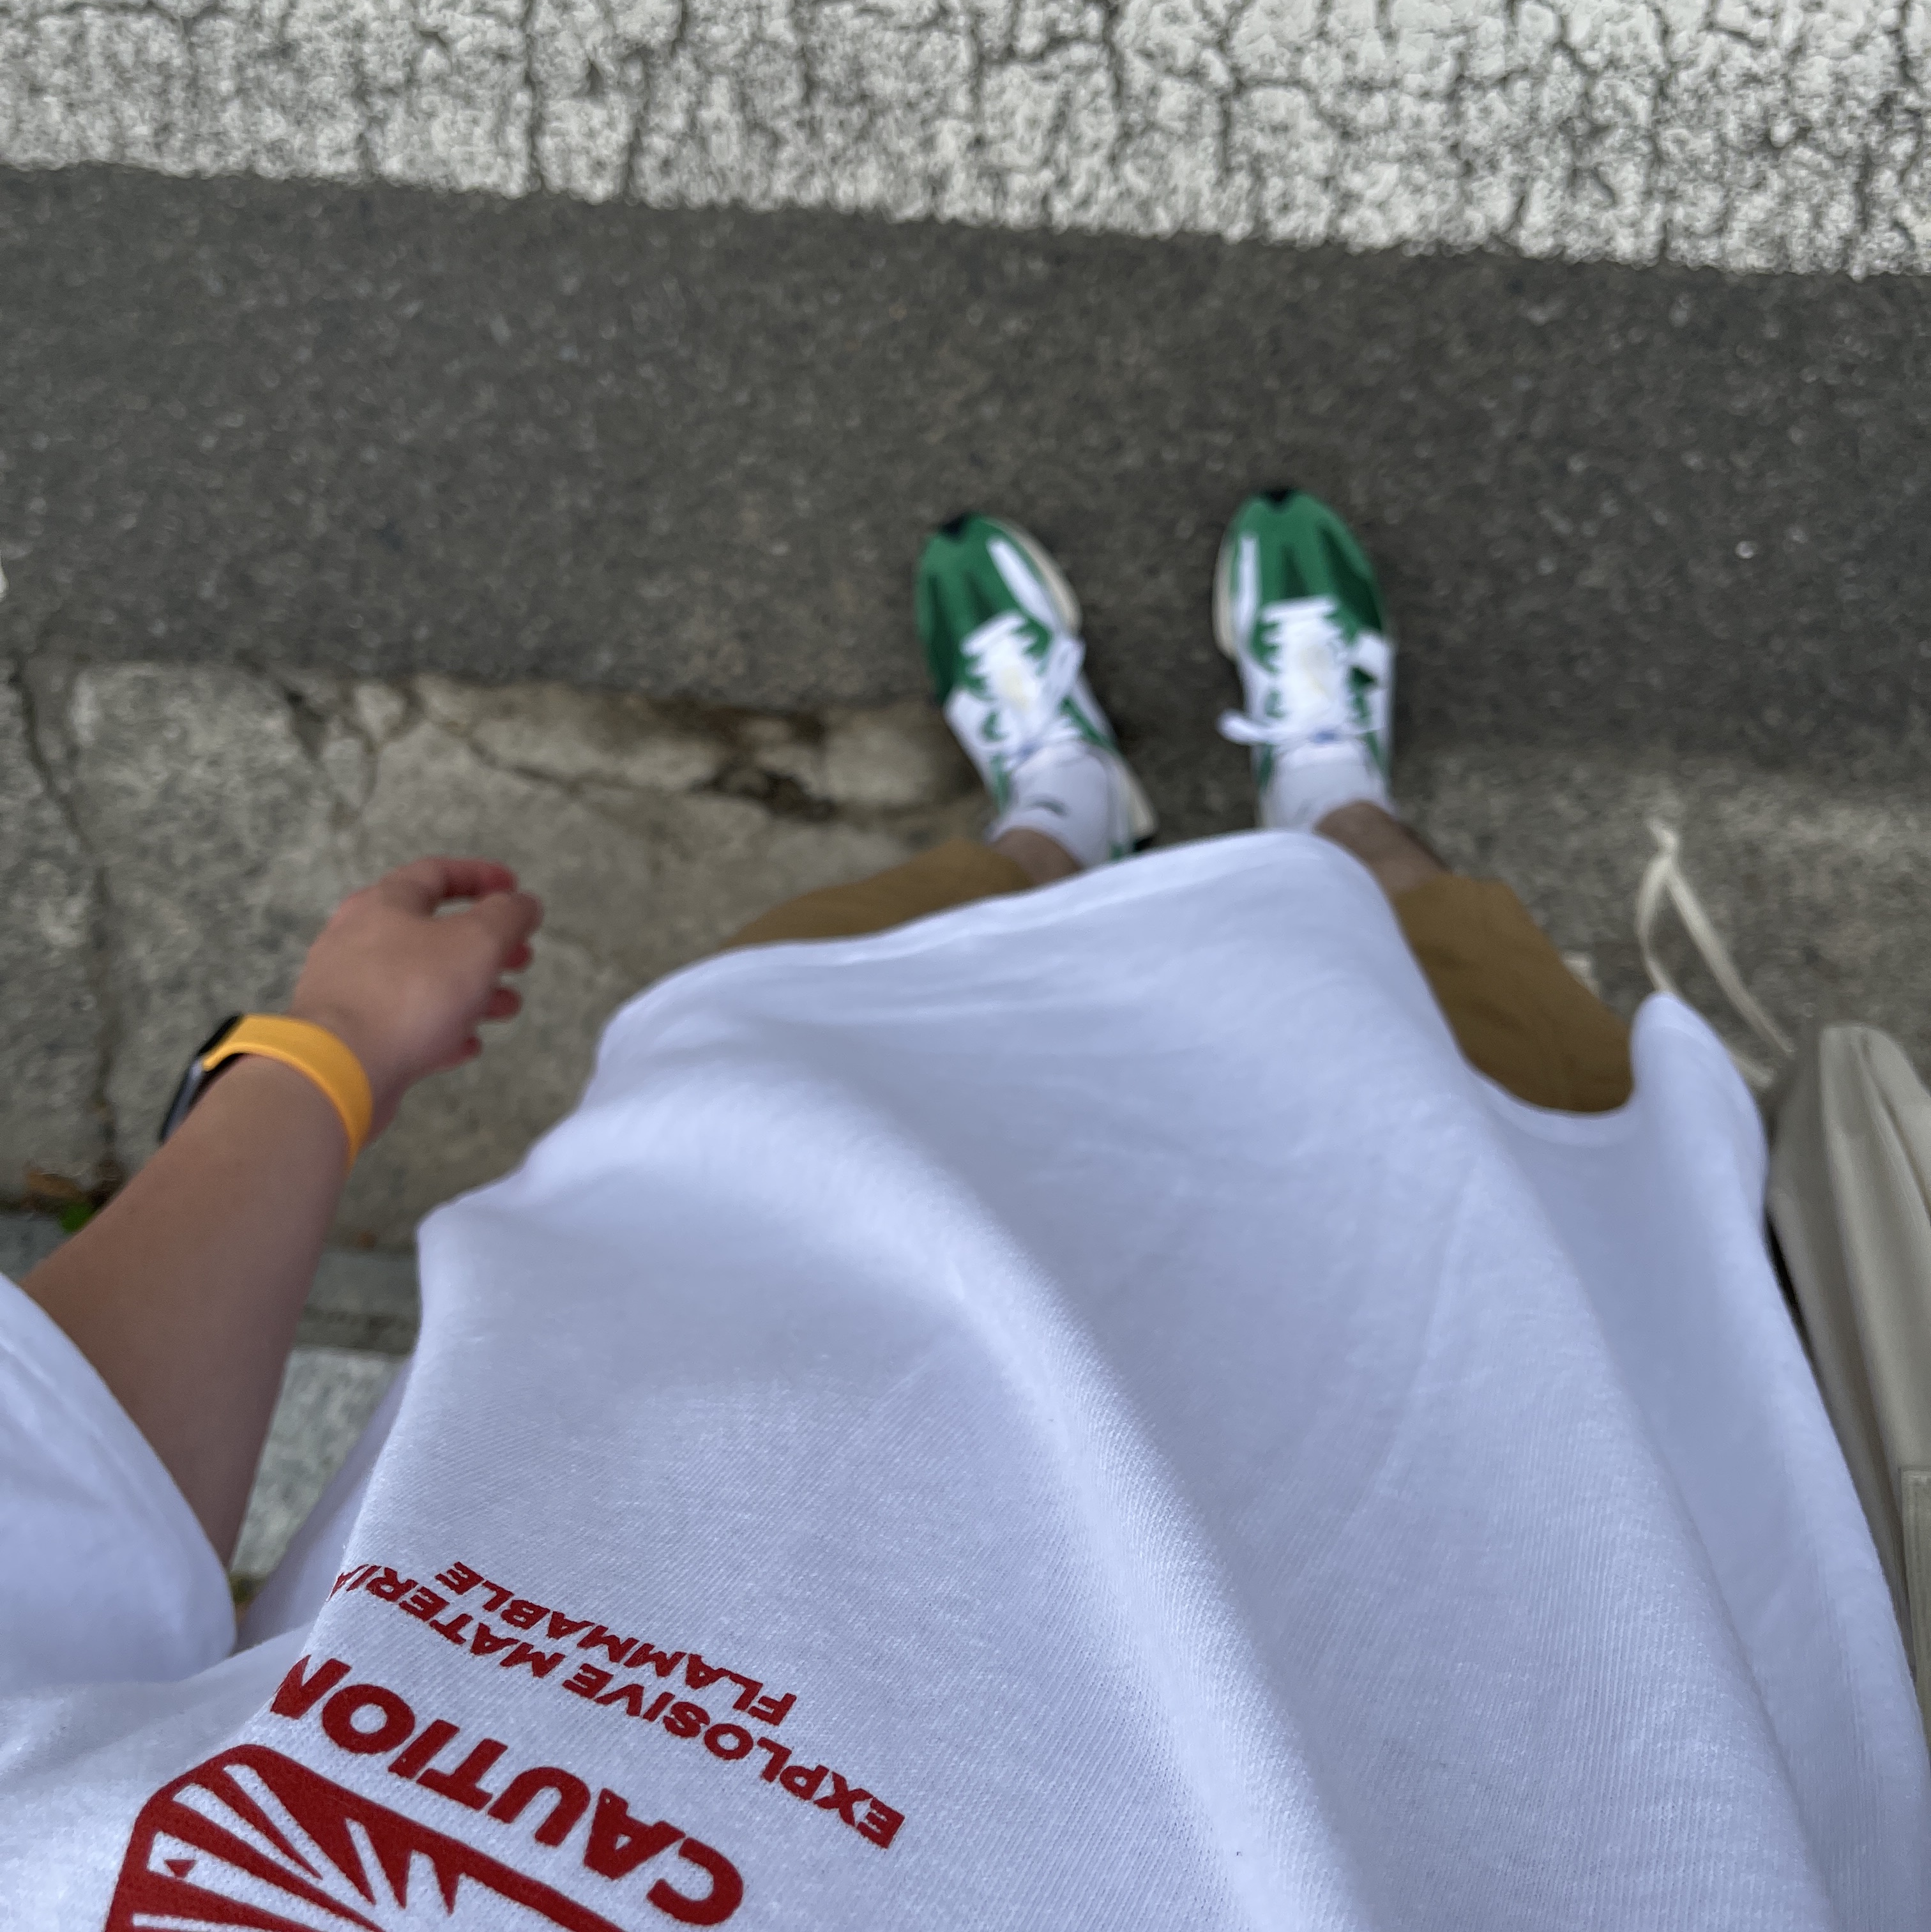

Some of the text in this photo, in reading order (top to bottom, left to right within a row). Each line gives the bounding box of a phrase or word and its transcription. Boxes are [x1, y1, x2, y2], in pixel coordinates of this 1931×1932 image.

[437, 1563, 795, 1725] FLAMMABLE
[272, 1660, 742, 1925] CAUTION
[564, 1664, 903, 1848] EXPLOSIVE
